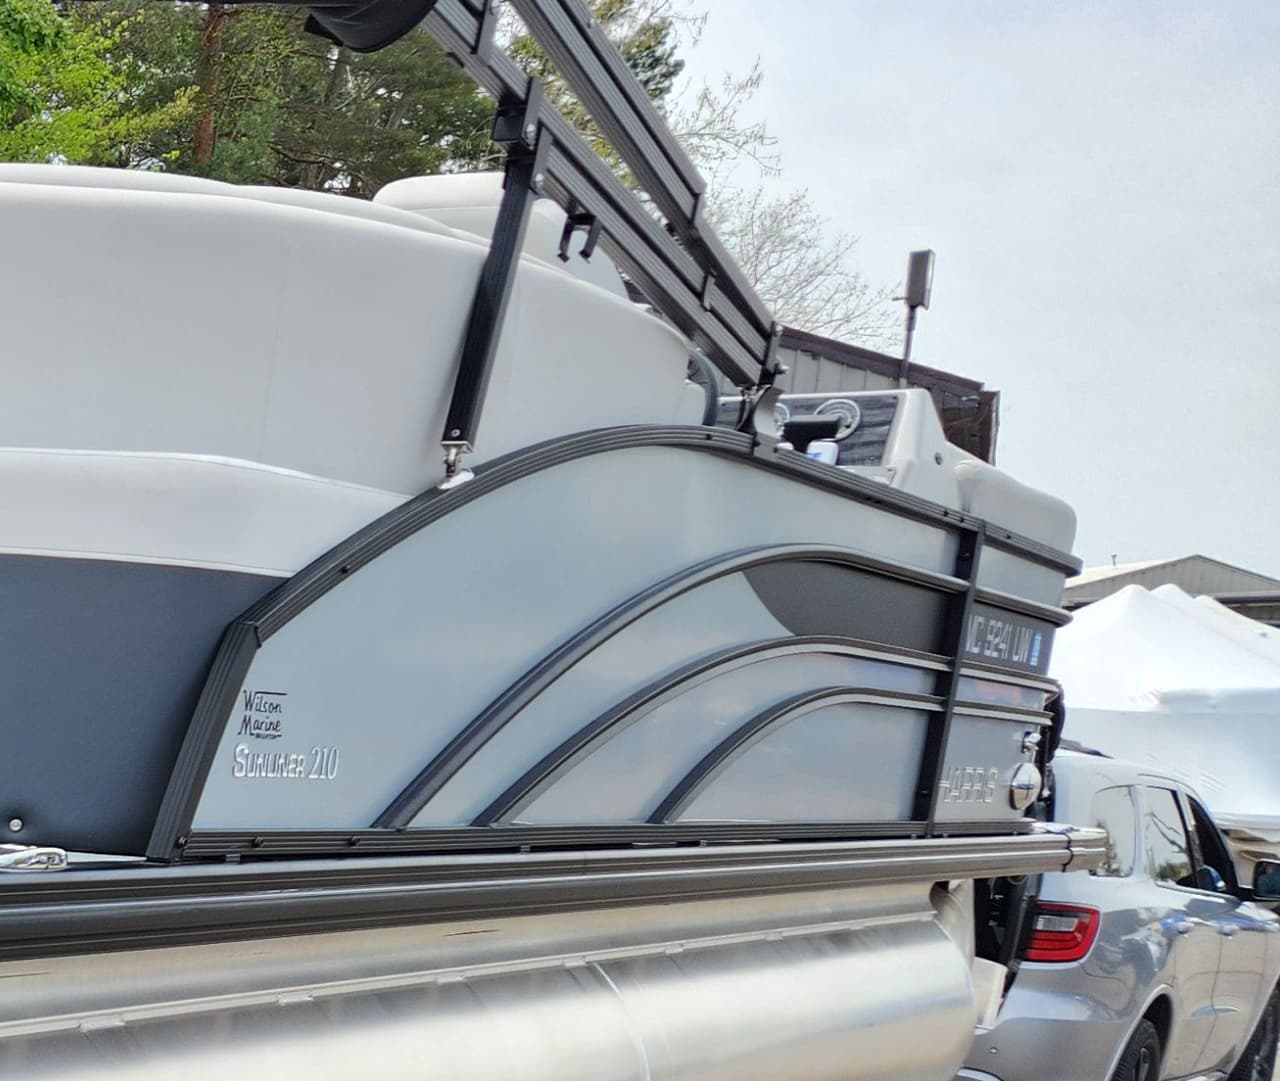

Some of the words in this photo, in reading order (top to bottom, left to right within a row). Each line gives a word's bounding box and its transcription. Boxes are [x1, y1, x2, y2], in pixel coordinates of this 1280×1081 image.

[243, 690, 283, 713] Wilson
[238, 714, 282, 736] Marine
[308, 745, 339, 780] 210
